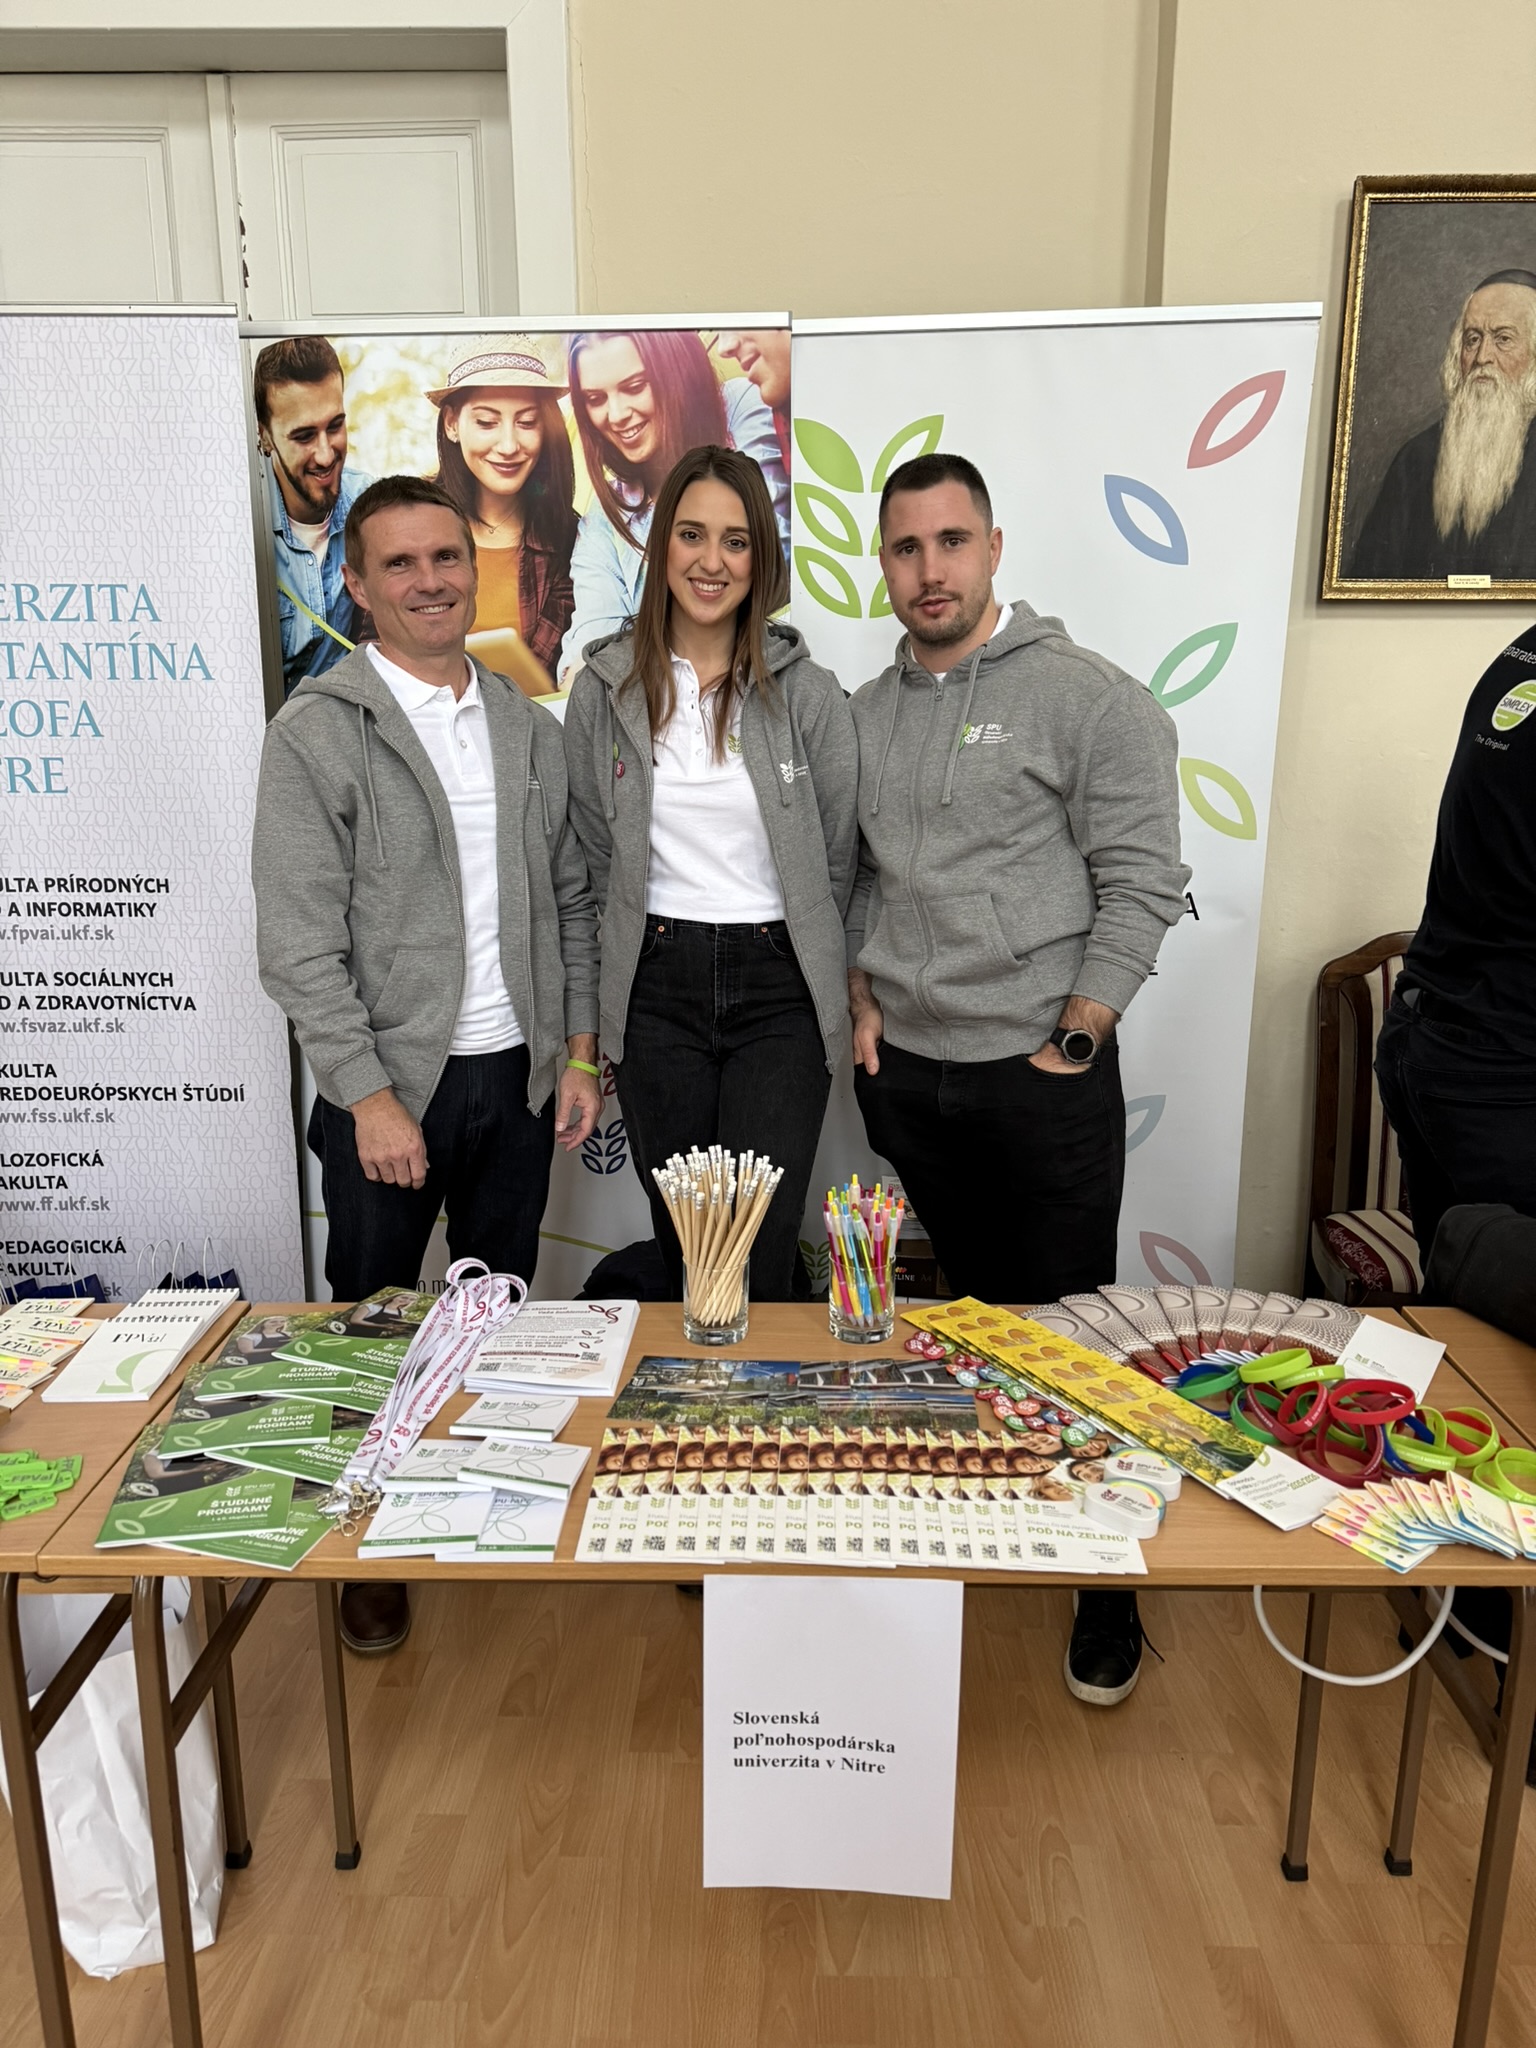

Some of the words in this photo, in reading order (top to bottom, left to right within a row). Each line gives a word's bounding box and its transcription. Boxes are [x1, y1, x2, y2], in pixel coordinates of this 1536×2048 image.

[0, 632, 215, 681] TANTÍNA
[1500, 697, 1532, 714] SIMPLEX
[0, 699, 104, 738] OFA
[1475, 733, 1485, 744] The
[1485, 737, 1510, 751] Original
[0, 756, 69, 793] RE
[0, 877, 39, 893] LTA
[44, 874, 170, 893] PRÍRODNÝCH
[8, 902, 21, 917] A
[26, 902, 157, 918] INFORMATIKY
[54, 968, 174, 988] SOCIÁLNYCH
[17, 996, 31, 1010] A
[36, 992, 197, 1011] ZDRAVOTNÍCTVA
[0, 1083, 176, 1101] REDOEURÓPSKYCH
[183, 1083, 245, 1102] ŠTÚDIÍ
[0, 1196, 110, 1211] ww.ff.ukf.sk
[247, 1420, 314, 1430] PROGRAMY
[258, 1413, 315, 1424] ŠTUDIJNÉ
[295, 1448, 351, 1465] PROGRAM
[210, 1495, 273, 1508] ŠTUDIJNÉ
[197, 1504, 271, 1517] PROGRAMY
[246, 1530, 300, 1545] OGRAMY
[1056, 1529, 1075, 1538] NA
[733, 1711, 820, 1725] Slovenská
[733, 1733, 896, 1754] poľnohospodárska
[733, 1755, 820, 1768] univerzita
[826, 1759, 836, 1769] v
[841, 1757, 886, 1774] Nitre
